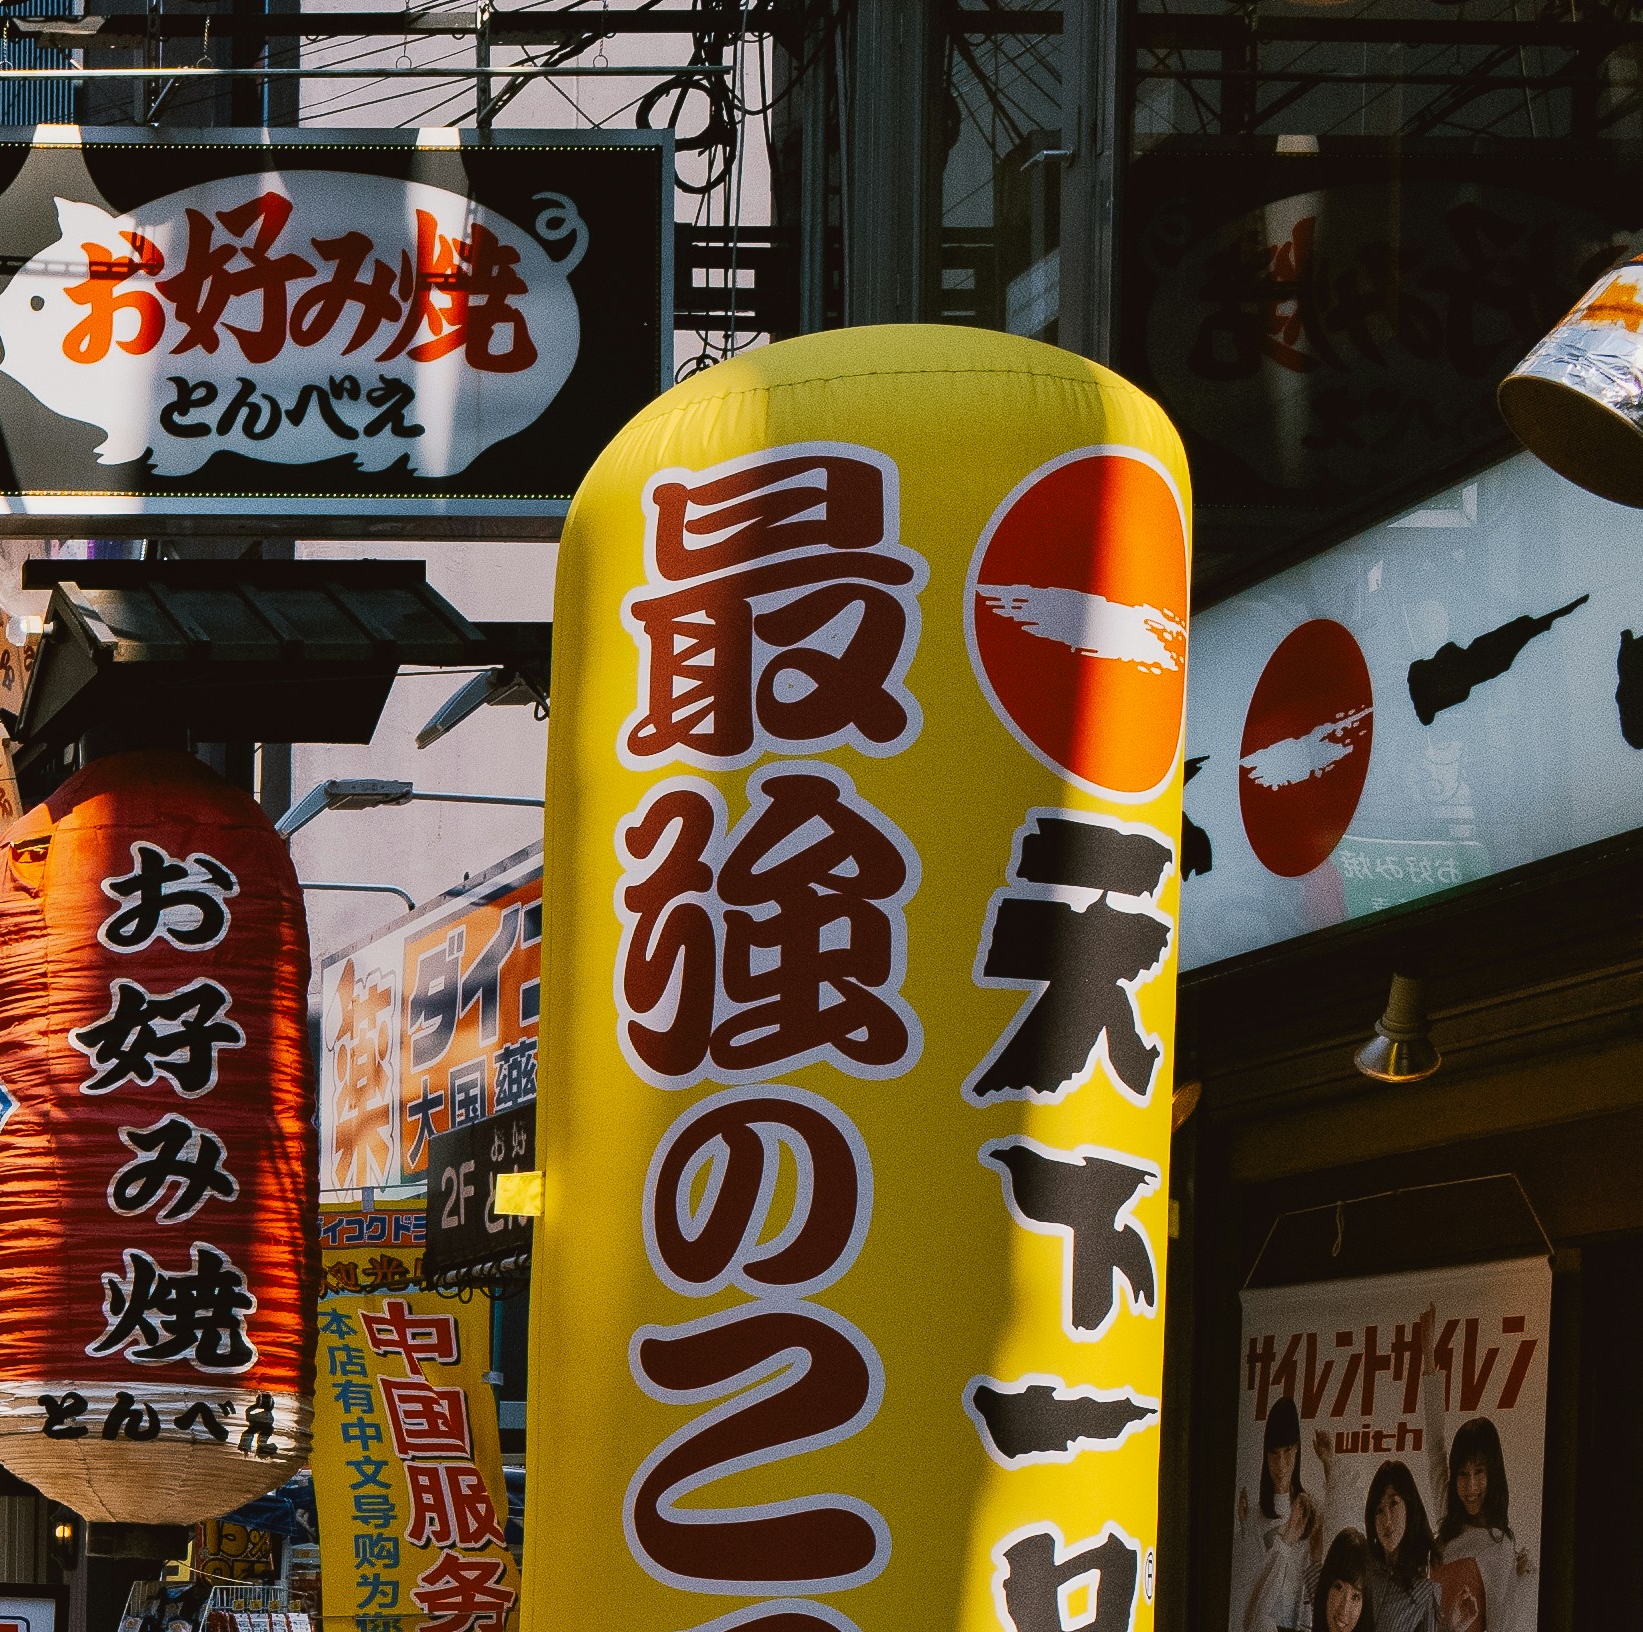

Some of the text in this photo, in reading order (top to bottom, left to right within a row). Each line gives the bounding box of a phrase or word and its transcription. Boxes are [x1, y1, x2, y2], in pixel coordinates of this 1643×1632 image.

[61, 191, 538, 373] お好み焼
[160, 375, 425, 441] とんべえ
[75, 842, 257, 1372] お好み焼
[441, 1160, 475, 1229] 2F
[1246, 1316, 1537, 1422] サイレントサイレン
[1334, 1422, 1423, 1454] with
